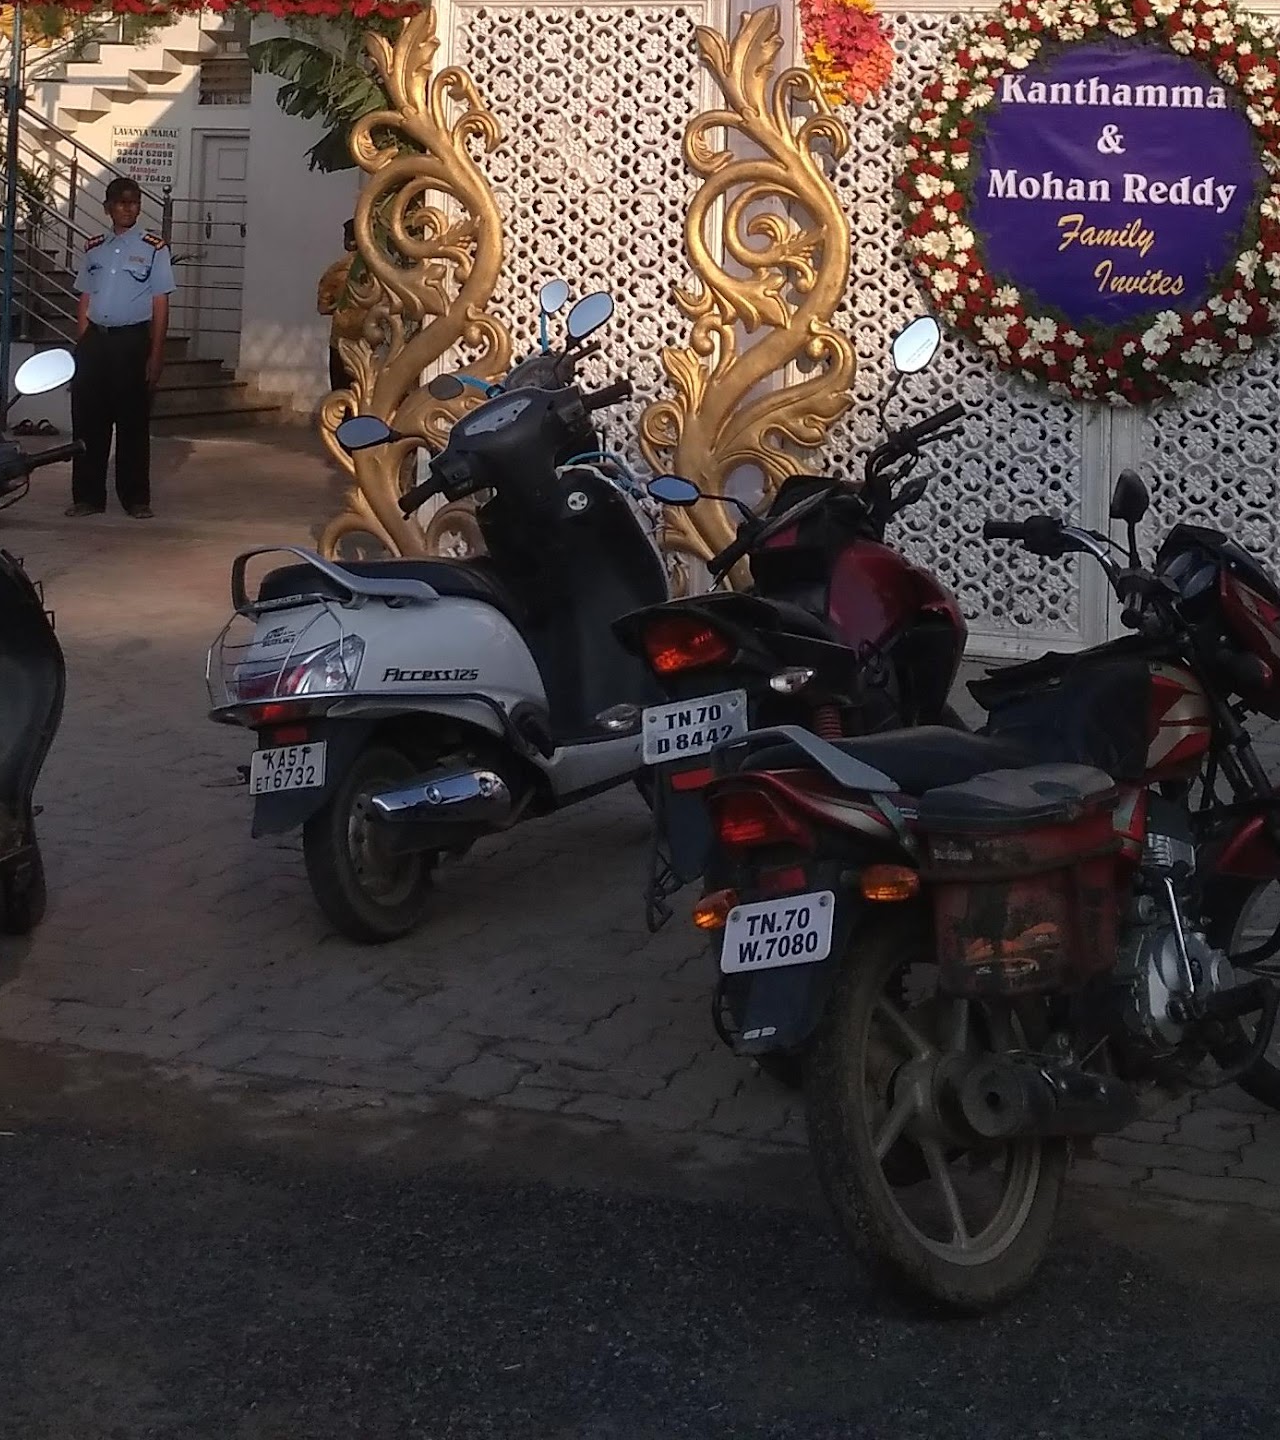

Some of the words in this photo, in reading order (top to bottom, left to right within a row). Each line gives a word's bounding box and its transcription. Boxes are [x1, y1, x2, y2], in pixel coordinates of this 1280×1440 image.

[1000, 73, 1228, 110] Kanthamma
[114, 127, 149, 137] LAVANYA
[151, 129, 177, 138] MAHAL
[1096, 124, 1127, 155] &
[987, 168, 1111, 203] Mohan
[1122, 173, 1238, 214] Reddy
[1056, 213, 1156, 258] Family
[1093, 259, 1186, 296] Invites
[664, 704, 722, 730] TN.70
[746, 907, 811, 937] TN.70
[738, 931, 819, 964] W.7080
